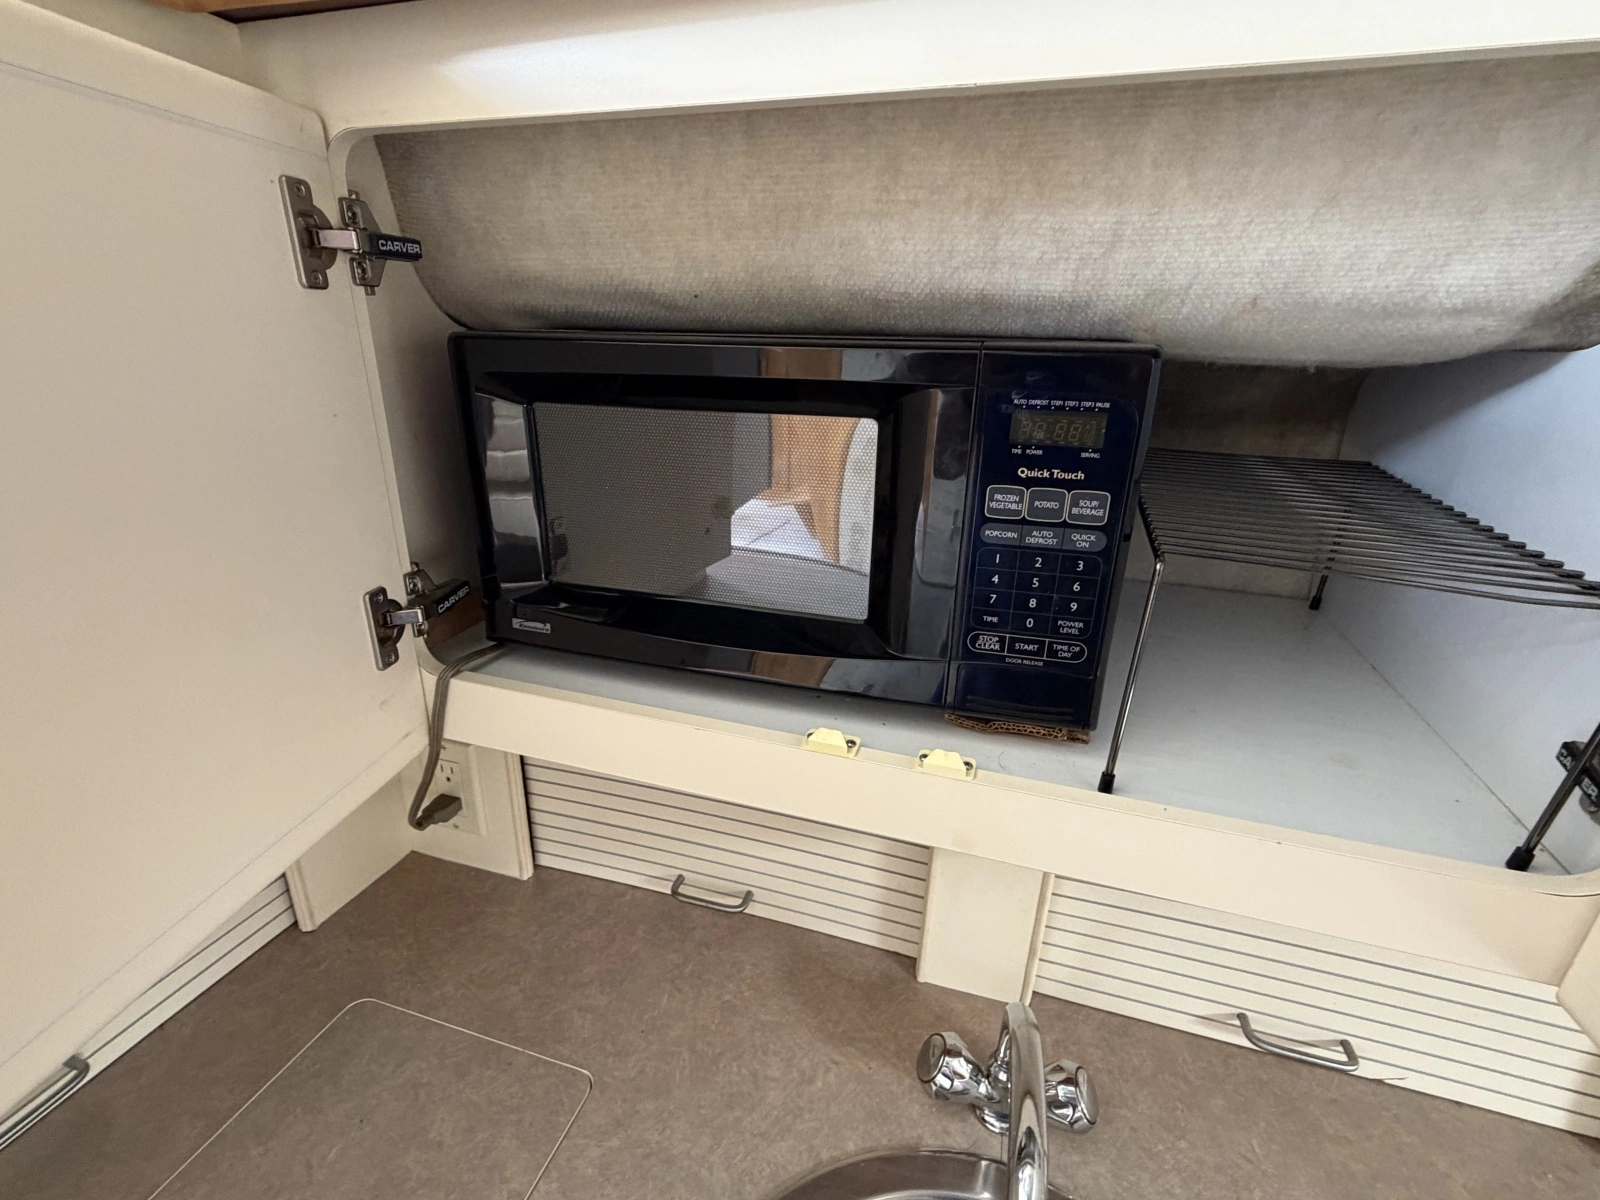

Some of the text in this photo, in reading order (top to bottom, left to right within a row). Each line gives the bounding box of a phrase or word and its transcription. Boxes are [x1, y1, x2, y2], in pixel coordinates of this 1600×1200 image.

[378, 239, 421, 254] CARVER
[1017, 467, 1085, 480] Quick Touch
[993, 493, 1019, 502] FROZEN
[989, 501, 1022, 510] VEGETABLE
[1033, 500, 1060, 509] POTATO
[1071, 507, 1105, 517] BEVERAGE
[985, 529, 1018, 539] POPCORN
[1031, 530, 1054, 538] AUTO
[1071, 533, 1097, 542] QUICK
[1025, 536, 1058, 546] DEFROST
[1076, 540, 1090, 548] ON
[996, 554, 1000, 564] 1
[1035, 557, 1042, 567] 2
[1076, 561, 1084, 571] 3
[991, 575, 999, 584] 4
[1032, 578, 1039, 587] 5
[1073, 582, 1080, 591] 6
[438, 586, 470, 613] CARVER
[989, 594, 997, 604] 7
[1029, 598, 1036, 608] 8
[1070, 603, 1077, 612] 9
[982, 615, 999, 623] TIME
[1026, 618, 1034, 628] 0
[1057, 620, 1084, 629] POWER
[1059, 627, 1080, 635] LEVEL
[978, 635, 999, 643] STOP
[975, 642, 1001, 651] CLEAR
[1014, 643, 1039, 652] START
[1052, 643, 1069, 652] TIME
[1022, 659, 1044, 667] RELEASE
[1558, 748, 1599, 801] CAER
